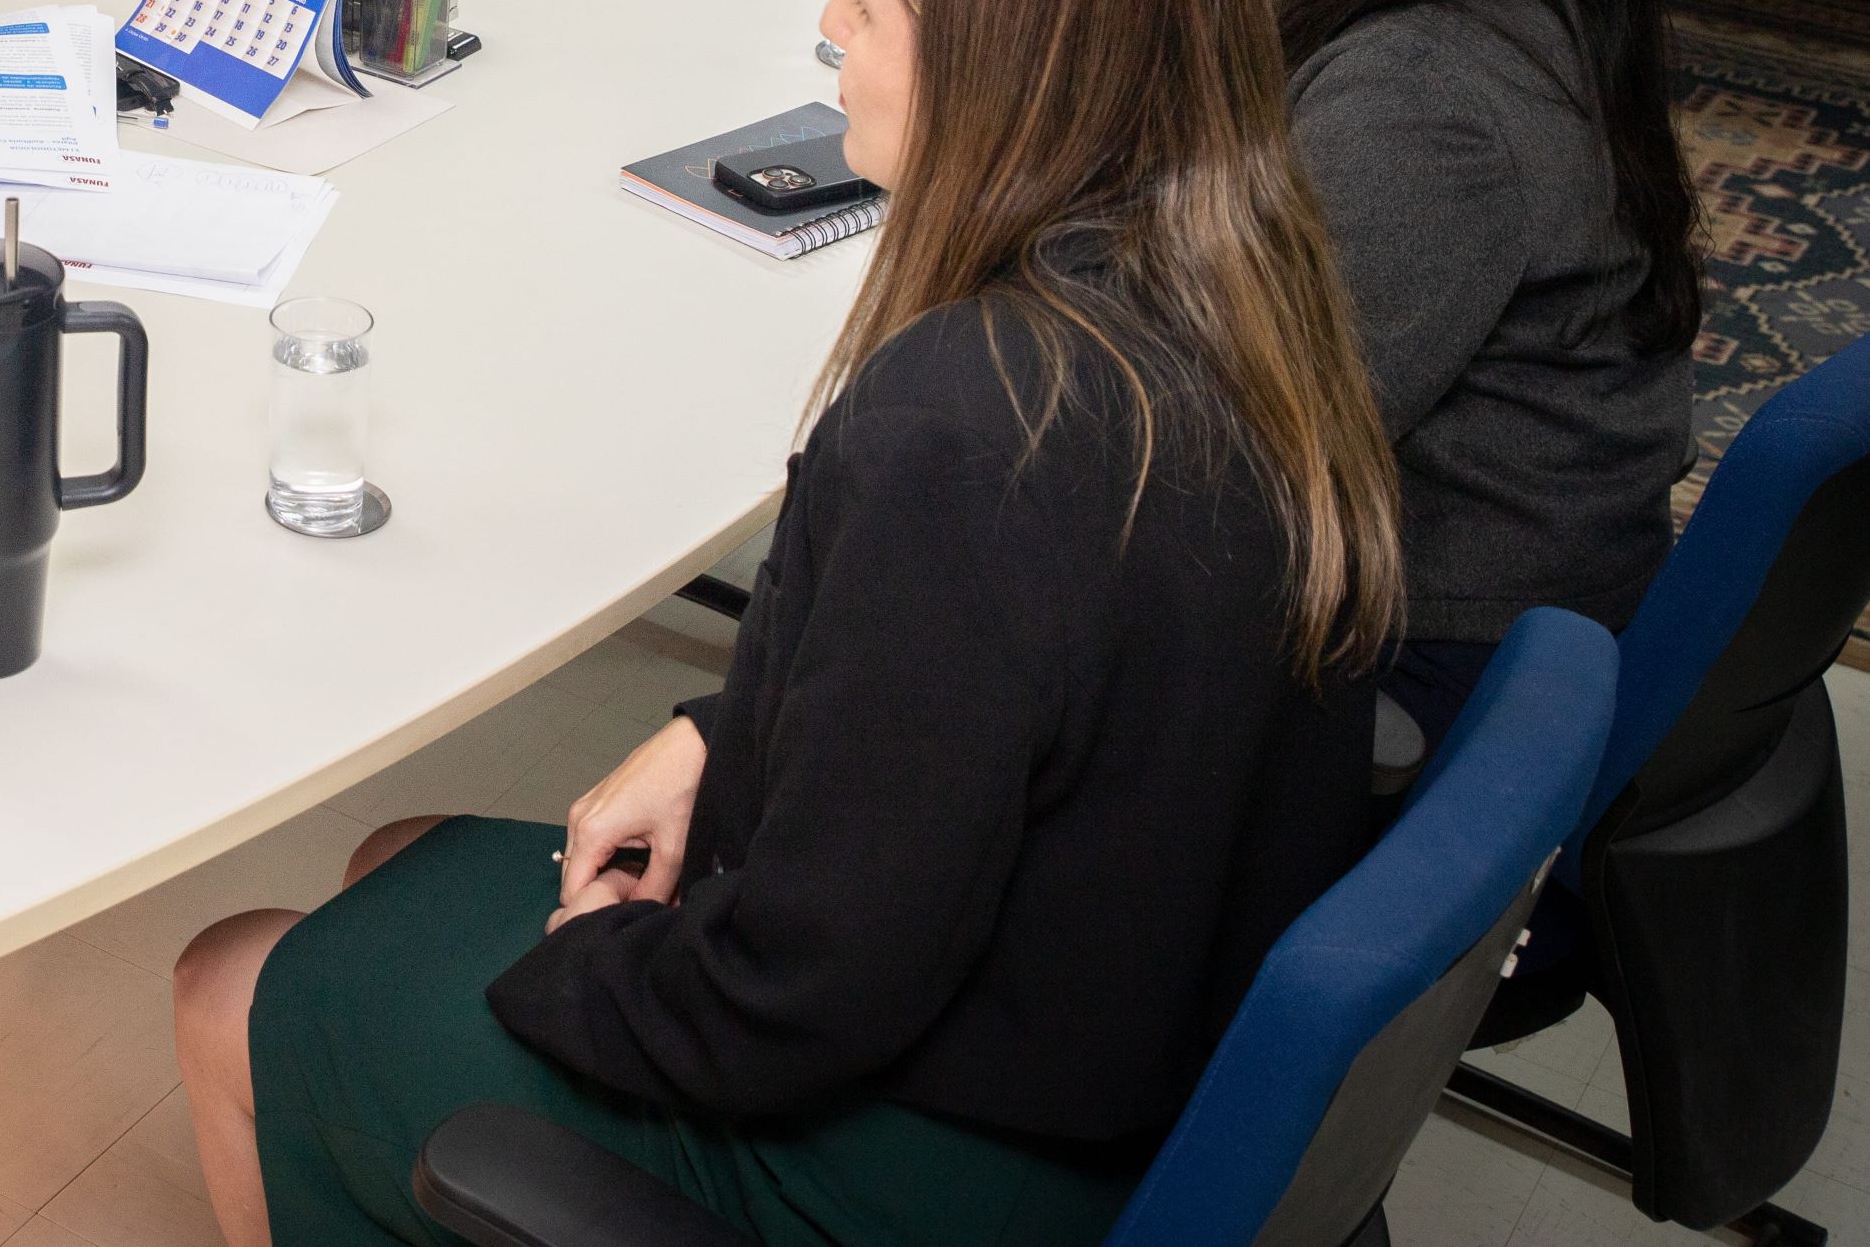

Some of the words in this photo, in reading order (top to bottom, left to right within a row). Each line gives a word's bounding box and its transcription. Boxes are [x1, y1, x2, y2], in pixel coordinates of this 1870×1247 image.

[241, 3, 251, 14] 11
[263, 13, 272, 24] 12
[284, 22, 293, 33] 13
[291, 6, 298, 15] 6
[135, 13, 148, 24] 28
[155, 23, 167, 33] 29
[174, 32, 187, 42] 30
[193, 0, 203, 11] 16
[213, 10, 223, 20] 17
[234, 20, 244, 30] 18
[255, 29, 265, 40] 19
[275, 39, 287, 50] 20
[165, 8, 176, 18] 22
[184, 17, 196, 27] 23
[204, 26, 217, 37] 24
[225, 36, 237, 47] 25
[246, 46, 258, 57] 26
[267, 56, 279, 66] 27
[62, 155, 101, 164] FUNASA
[69, 176, 109, 187] FUNASA
[60, 259, 92, 269] FUNA
